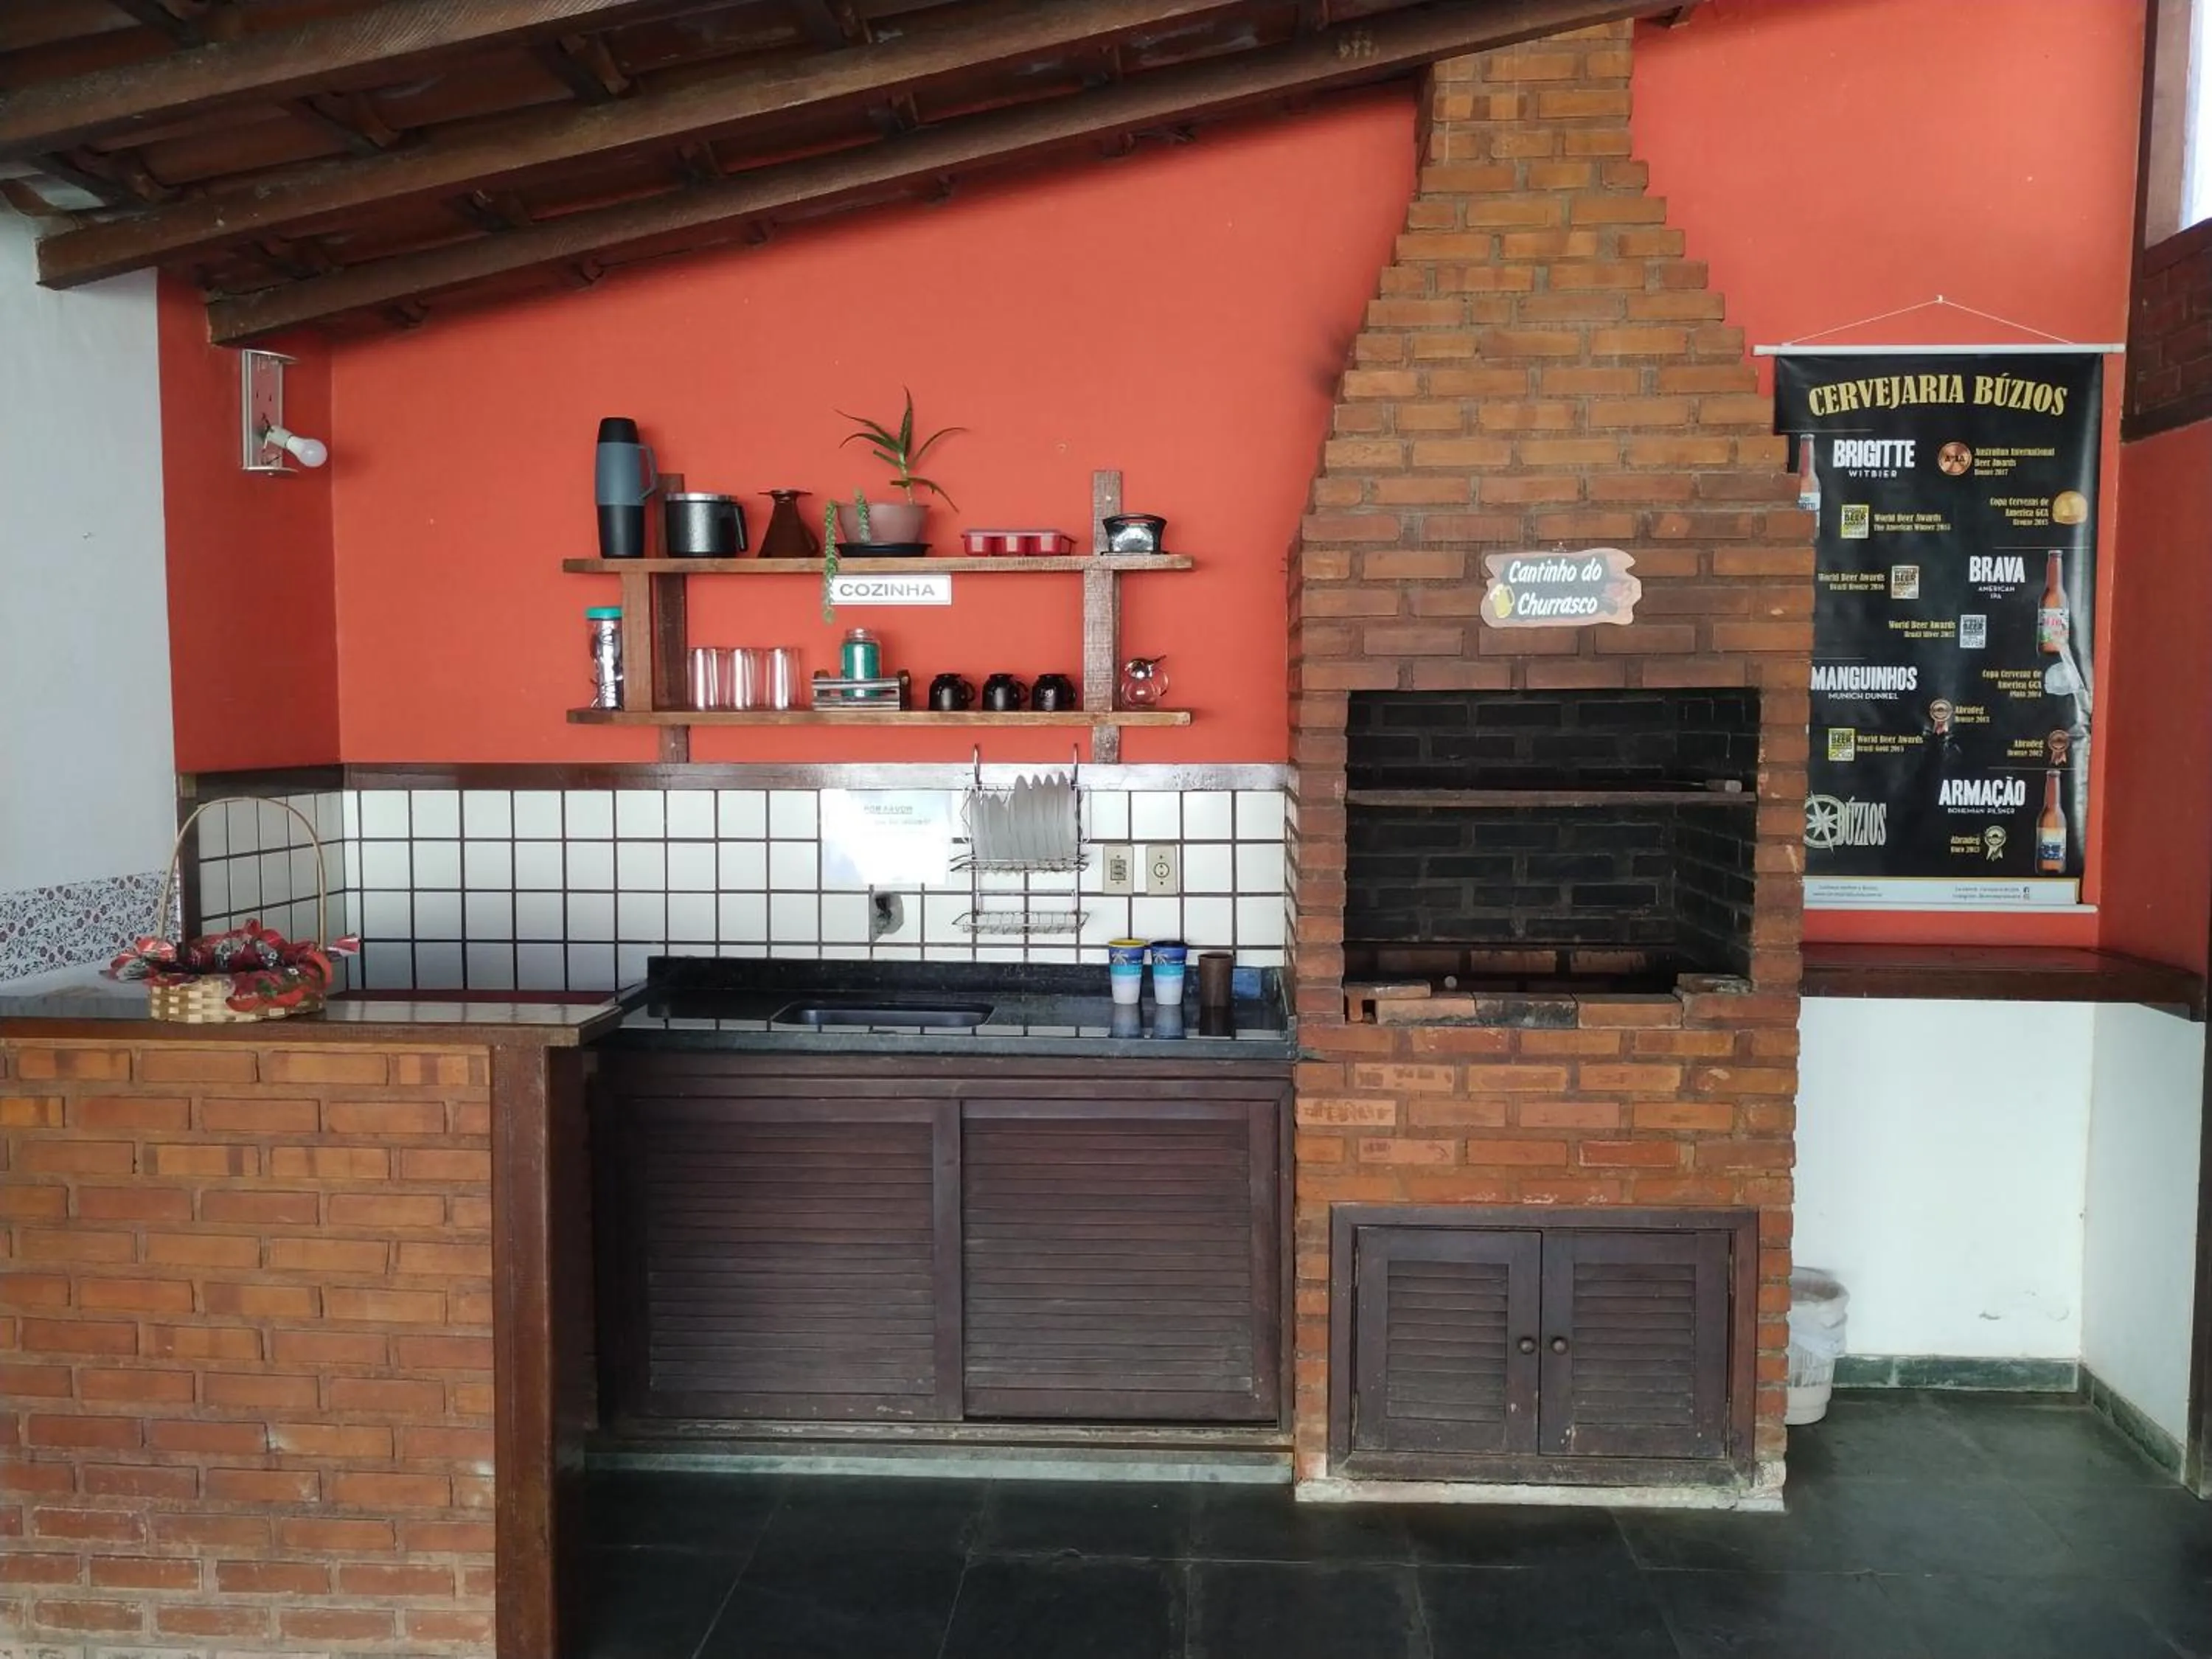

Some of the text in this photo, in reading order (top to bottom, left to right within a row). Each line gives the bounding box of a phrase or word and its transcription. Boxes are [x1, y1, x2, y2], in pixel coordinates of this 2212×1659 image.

[1809, 373, 2068, 416] CERVEJARIA BÚZIOS
[1833, 439, 1916, 467] BRIGITTE
[1975, 459, 1991, 467] Beer
[1848, 470, 1897, 479] WITBIER
[1509, 557, 1602, 583] Cantinho do
[1840, 573, 1858, 581] Beer
[1969, 555, 2025, 583] BRAVA
[840, 583, 936, 597] COZINHA
[1517, 592, 1598, 616] Churrasco
[1888, 620, 1956, 629] World Beer Awards
[1811, 666, 1918, 691] MANGUINHOS
[1879, 735, 1896, 743] Beer
[1938, 776, 2026, 807] ARMAÇÃO
